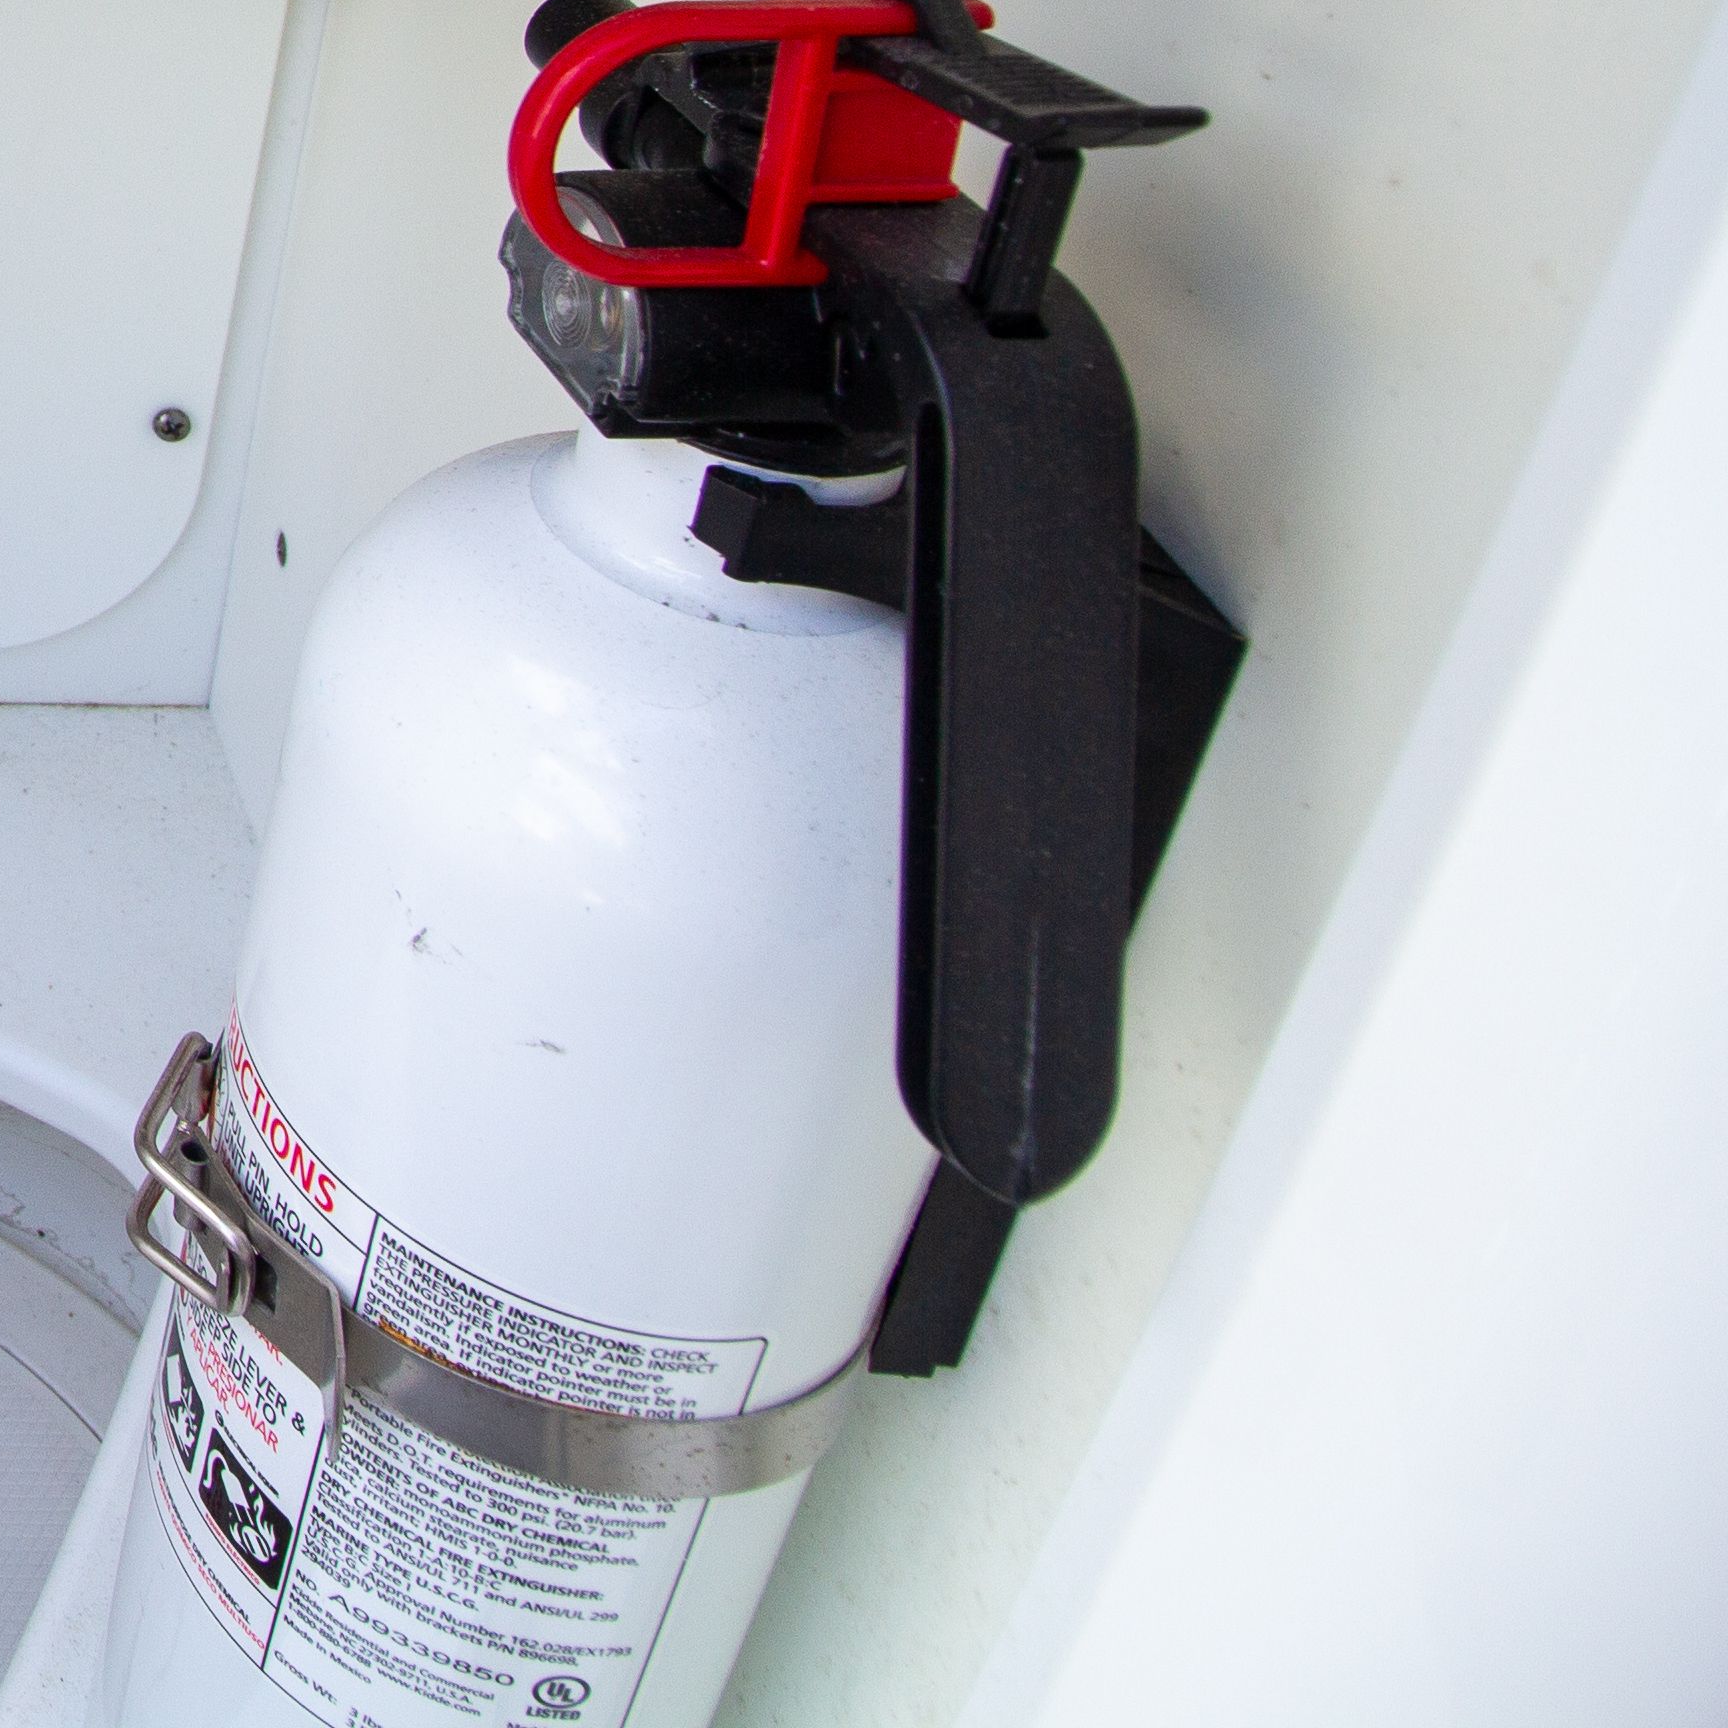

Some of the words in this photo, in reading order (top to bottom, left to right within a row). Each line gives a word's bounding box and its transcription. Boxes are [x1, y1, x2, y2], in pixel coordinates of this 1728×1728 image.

[224, 1129, 244, 1173] UNIT
[228, 1007, 336, 1214] RUCTIONS
[229, 1102, 246, 1159] PULL
[248, 1151, 271, 1200] PIN.
[275, 1193, 323, 1257] HOLD
[370, 1279, 450, 1338] vandalism.
[373, 1267, 453, 1326] frequently
[376, 1256, 493, 1333] EXTINGUISHER
[498, 1328, 589, 1368] MONTHLY
[594, 1364, 612, 1374] or
[617, 1368, 664, 1383] more
[379, 1243, 408, 1272] THE
[413, 1264, 494, 1319] PRESSURE
[498, 1315, 595, 1359] INDICATOR
[600, 1352, 643, 1367] AND
[647, 1359, 718, 1374] INSPECT
[381, 1232, 504, 1311] MAINTENANCE
[508, 1306, 646, 1355] INSTRUCTIONS:
[651, 1348, 710, 1362] CHECK
[207, 1344, 279, 1454] PRESIONAR
[222, 1345, 251, 1395] SIDE
[255, 1389, 277, 1425] TO
[240, 1346, 287, 1417] LEVER
[291, 1412, 305, 1436] &
[351, 1388, 413, 1437] Portable
[417, 1432, 446, 1456] Fire
[312, 1505, 369, 1554] MARINE
[373, 1550, 411, 1581] TYPE
[416, 1576, 479, 1611] U.S.C.G.
[321, 1470, 351, 1496] DRY
[354, 1496, 433, 1551] CHEMICAL
[439, 1547, 473, 1567] FIRE
[478, 1564, 604, 1601] EXTINGUISHER:
[442, 1497, 479, 1519] ABC
[481, 1513, 518, 1533] DRY
[522, 1526, 610, 1554] CHEMICAL
[296, 1569, 320, 1595] NO.
[328, 1594, 515, 1687] A99339850
[525, 1706, 581, 1720] LISTED
